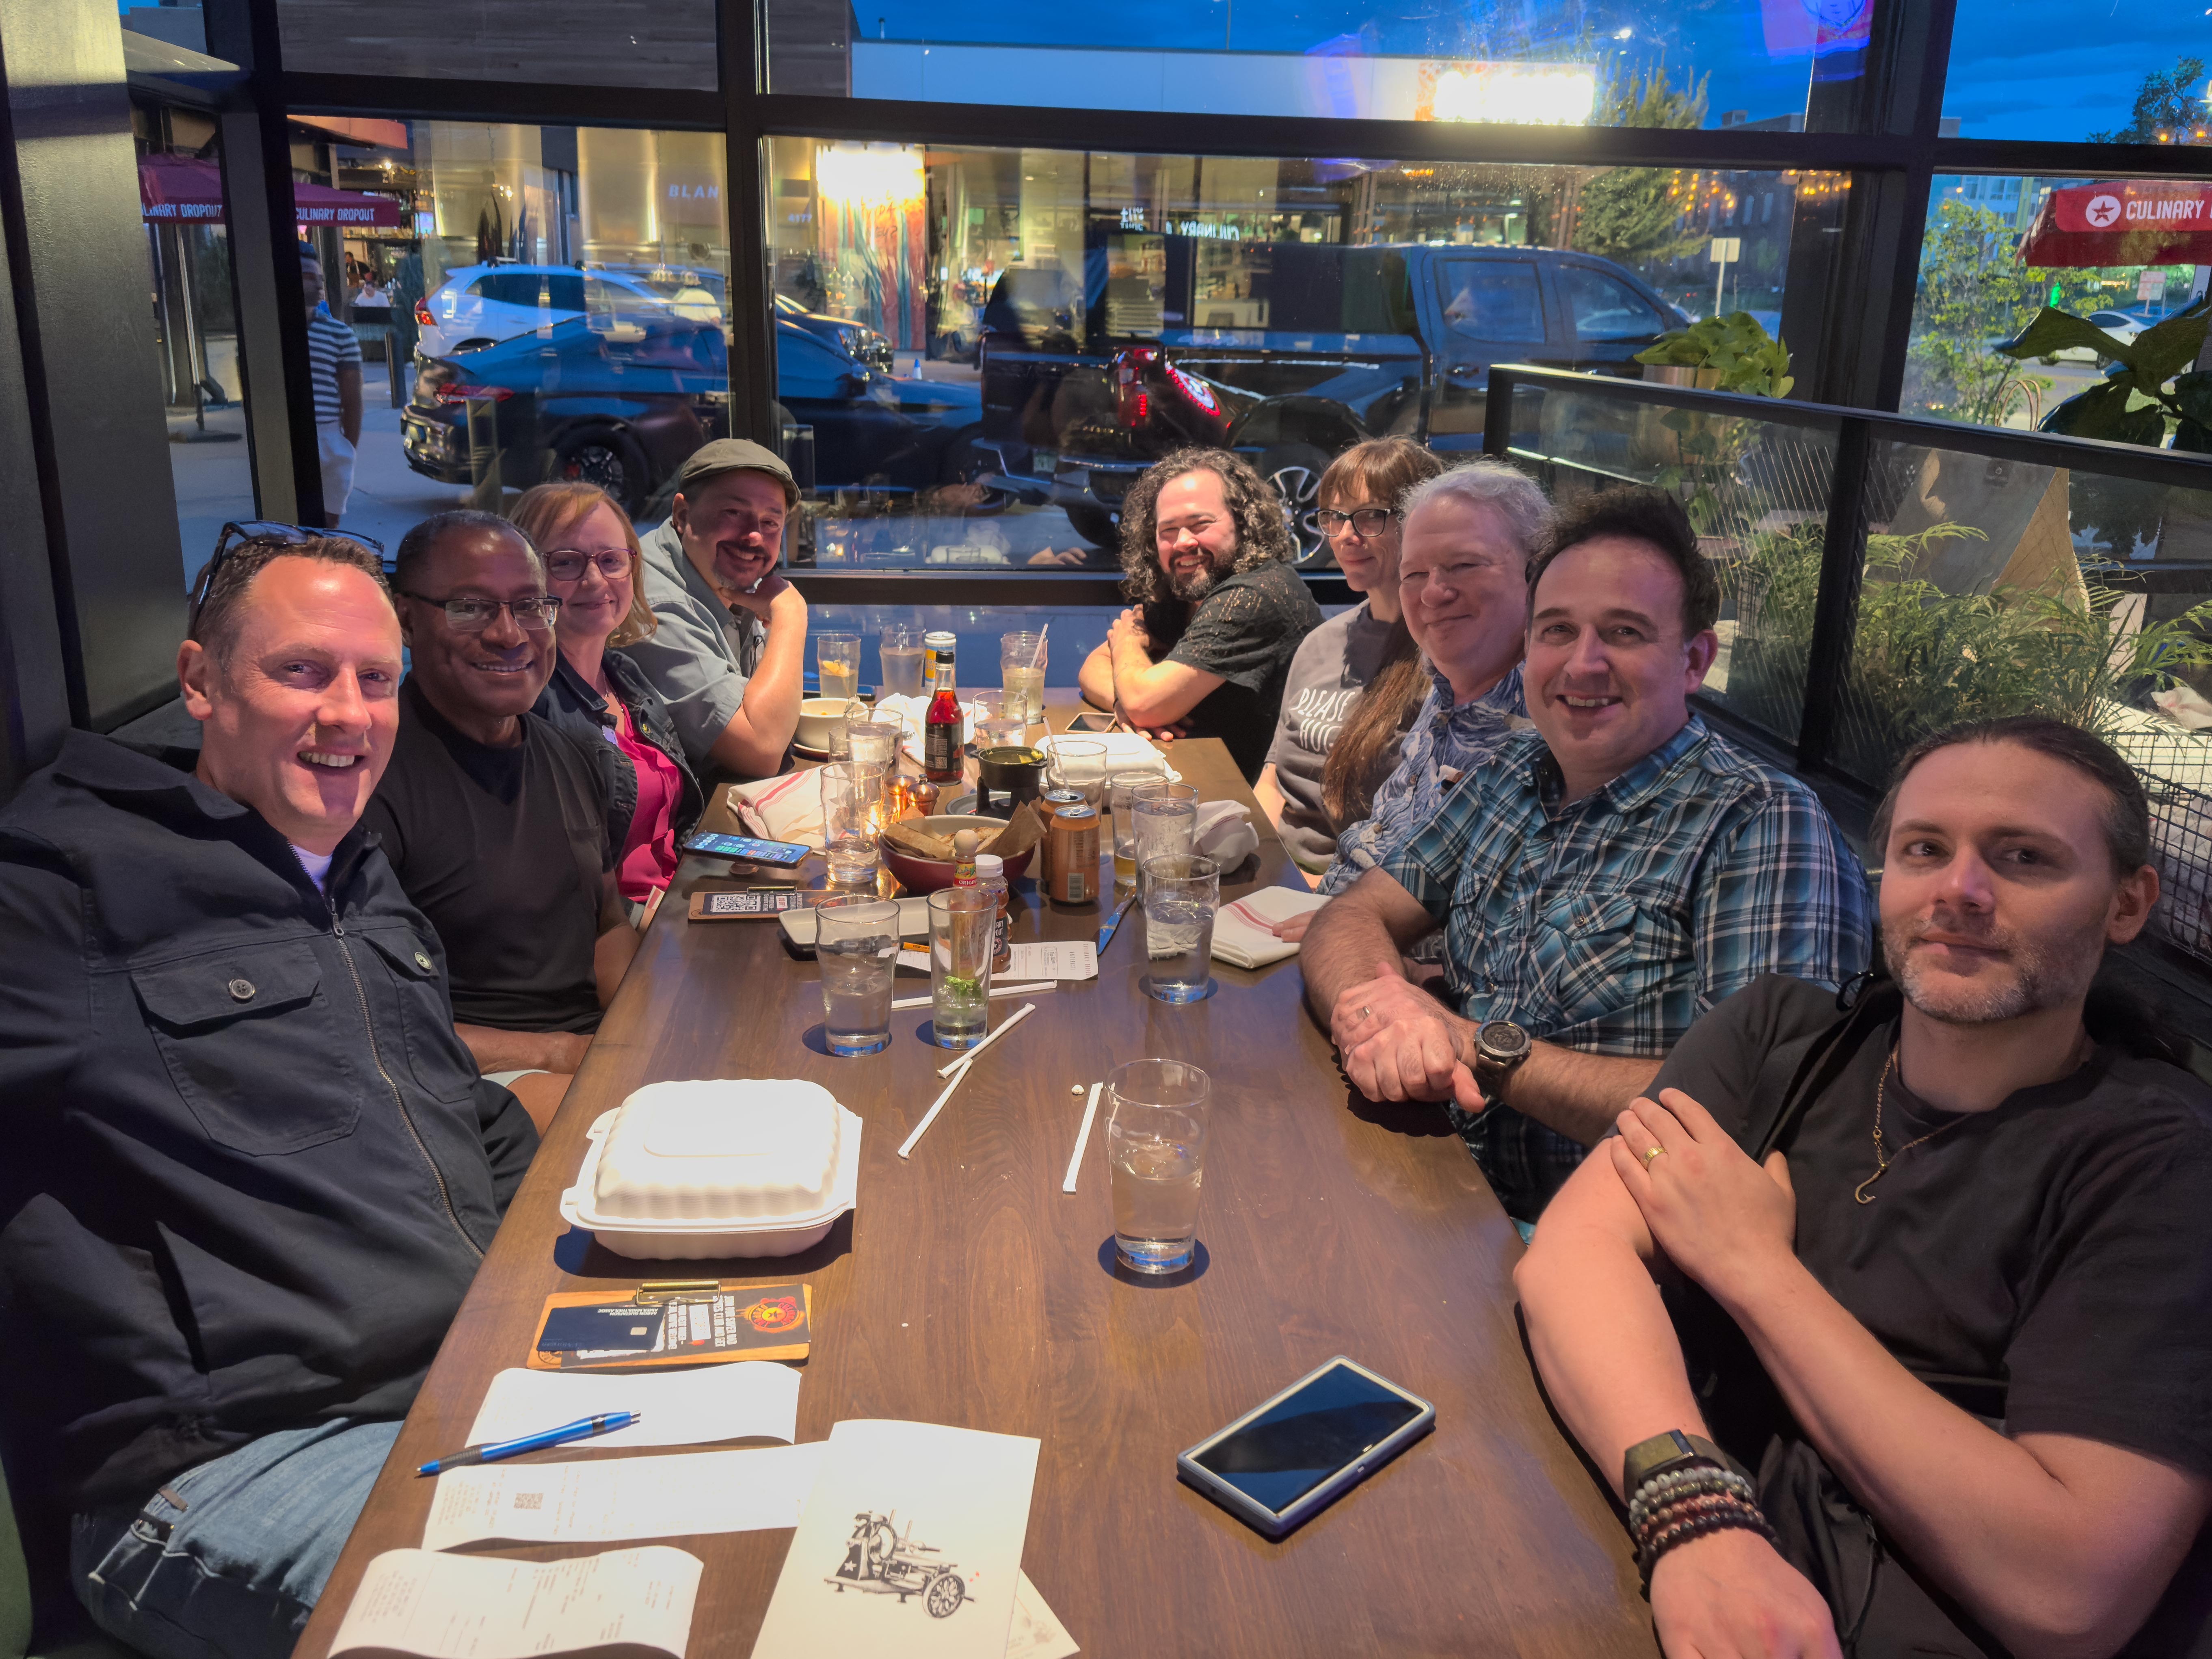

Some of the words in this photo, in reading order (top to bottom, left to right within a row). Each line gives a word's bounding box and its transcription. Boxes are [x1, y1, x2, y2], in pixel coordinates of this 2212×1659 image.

[180, 204, 223, 217] DROPOUT
[337, 208, 374, 221] DROPOUT
[2126, 200, 2205, 220] CULINARY
[1289, 688, 1356, 722] PLEASE
